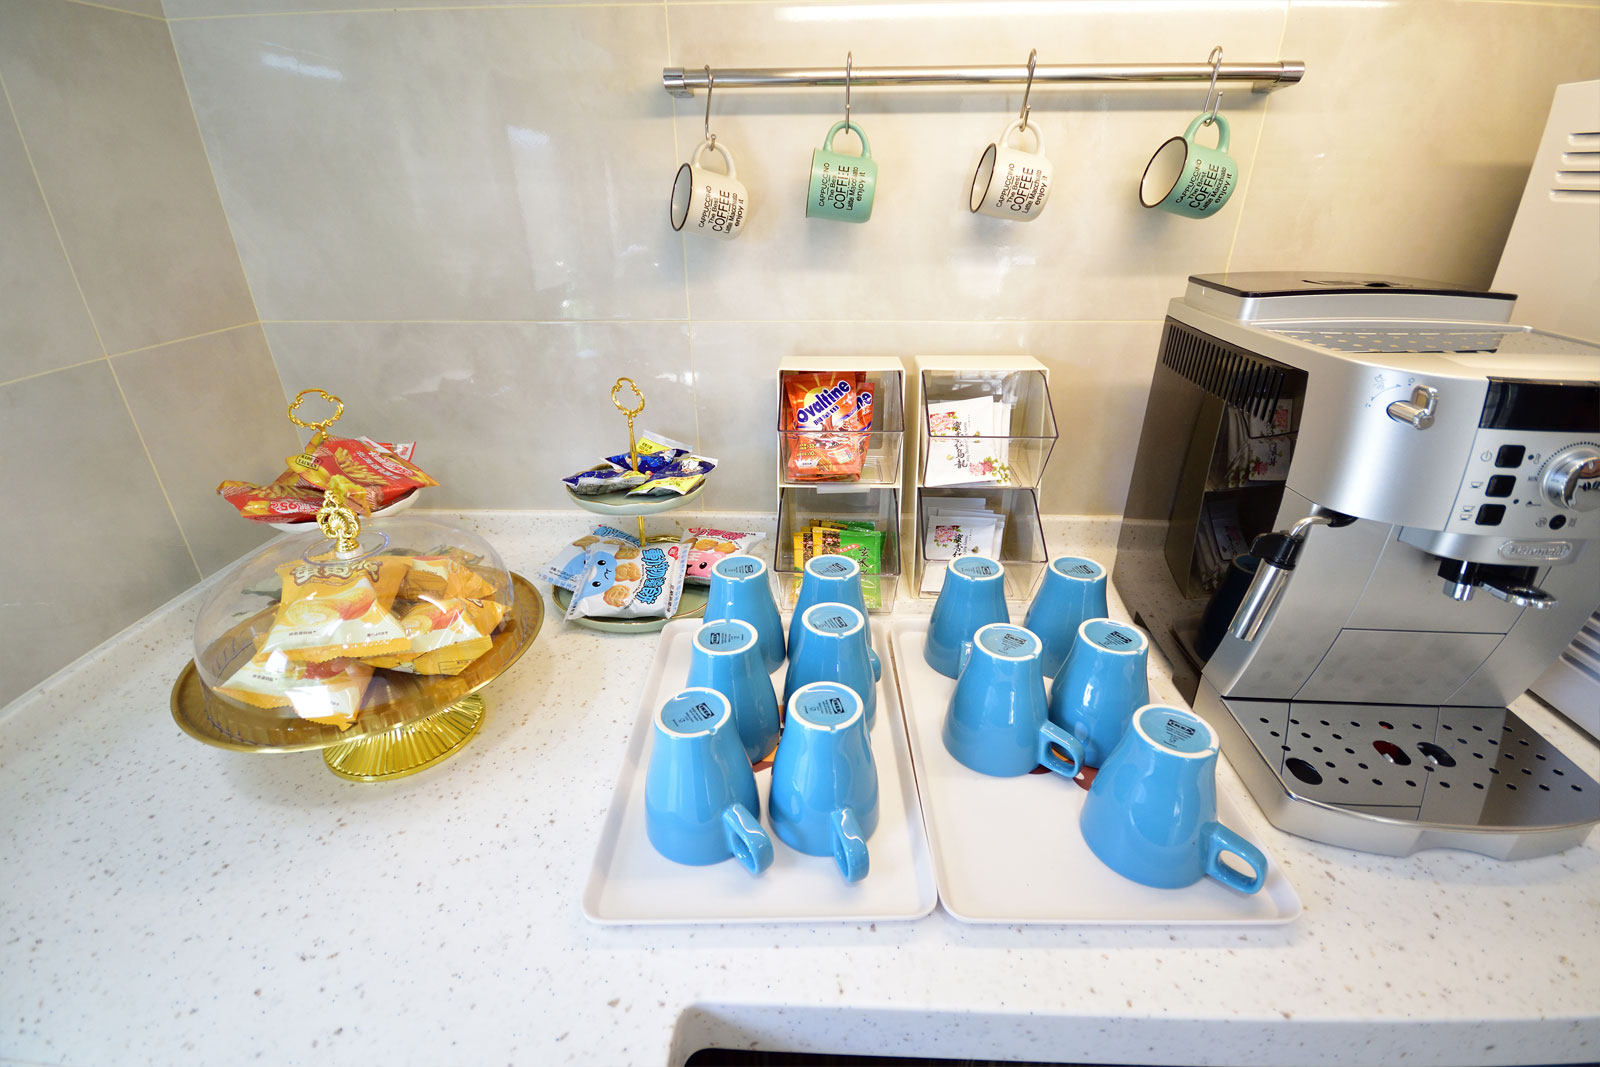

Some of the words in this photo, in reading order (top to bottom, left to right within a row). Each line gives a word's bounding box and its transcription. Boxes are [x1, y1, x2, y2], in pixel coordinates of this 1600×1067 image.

[819, 162, 830, 207] CAPPUCCNO
[833, 165, 850, 209] COFFEE
[996, 163, 1015, 208] CAPPUCCINO
[1010, 167, 1034, 212] COFFEE
[1176, 159, 1202, 203] CAPPUCCINO
[1189, 163, 1220, 208] COFFEE
[698, 185, 712, 228] CAPPUCCINO
[712, 189, 730, 232] COFFEE
[797, 380, 851, 424] Ovaltine
[1168, 720, 1194, 734] IKEA
